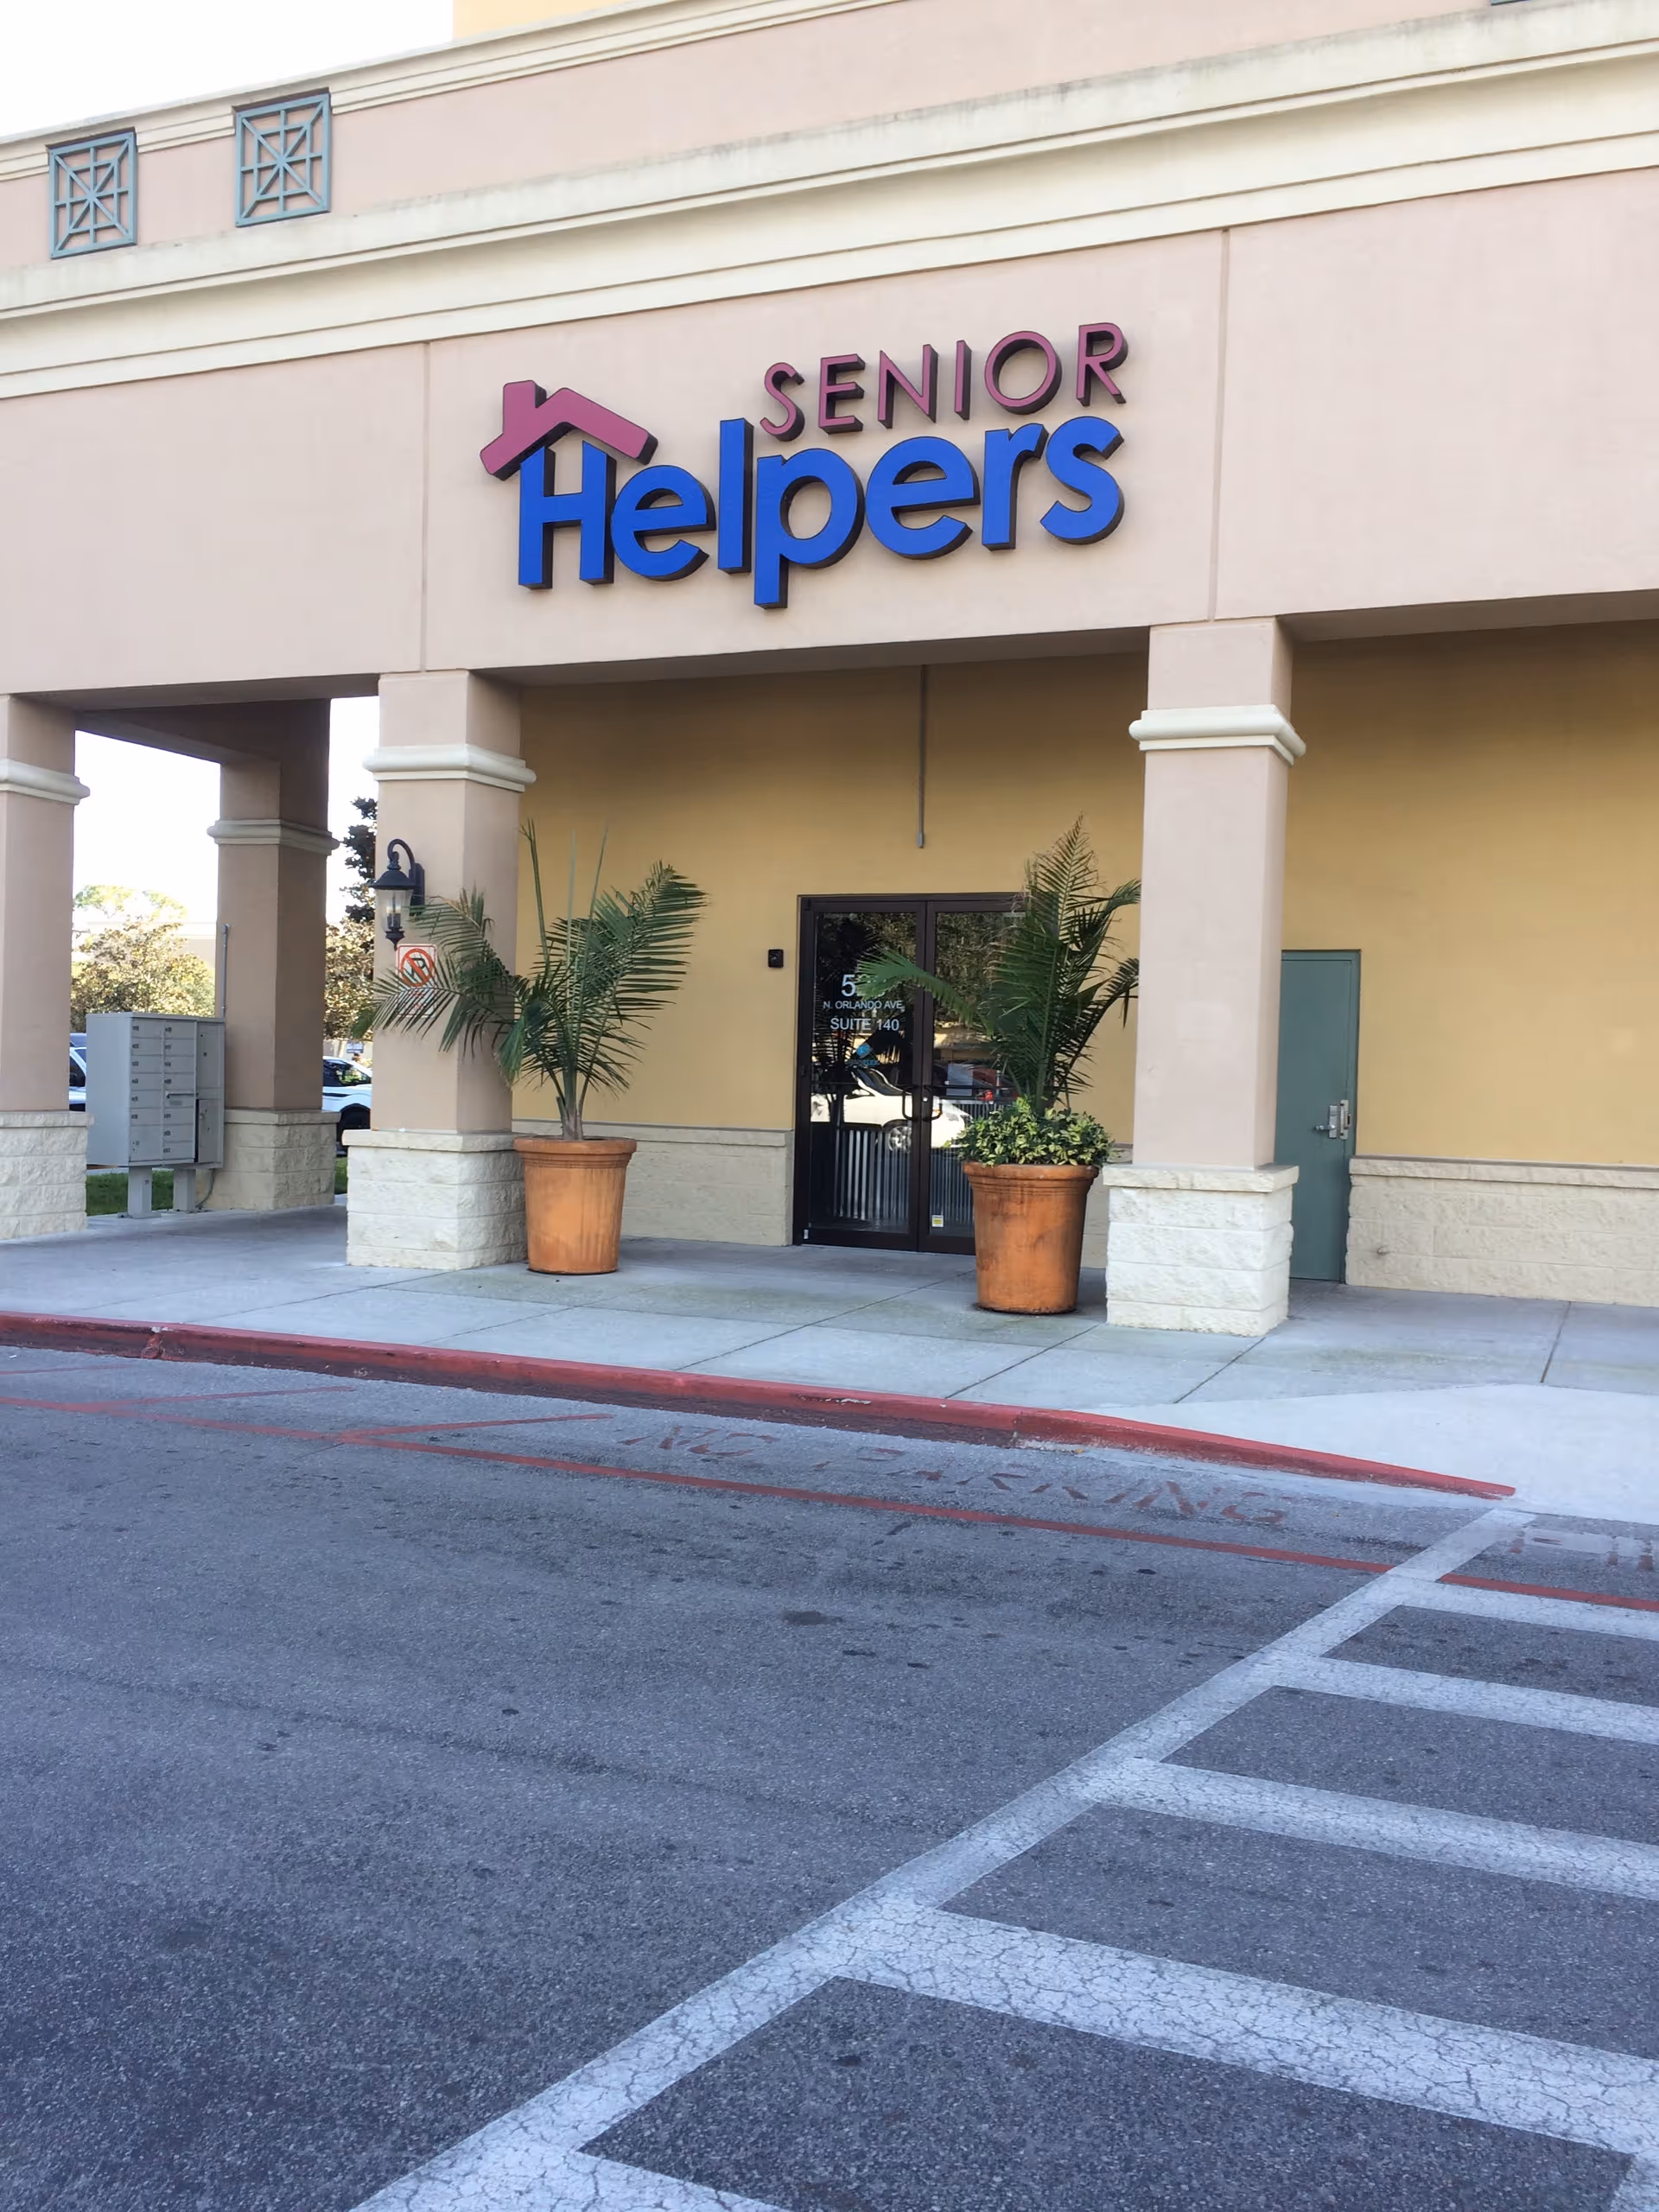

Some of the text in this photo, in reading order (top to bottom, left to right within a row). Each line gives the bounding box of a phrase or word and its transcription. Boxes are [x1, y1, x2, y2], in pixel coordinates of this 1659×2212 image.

[760, 321, 1128, 442] SENIOR
[518, 416, 1127, 609] Helpers
[830, 1018, 899, 1031] SUITE 140
[836, 1001, 881, 1009] ORLANDO
